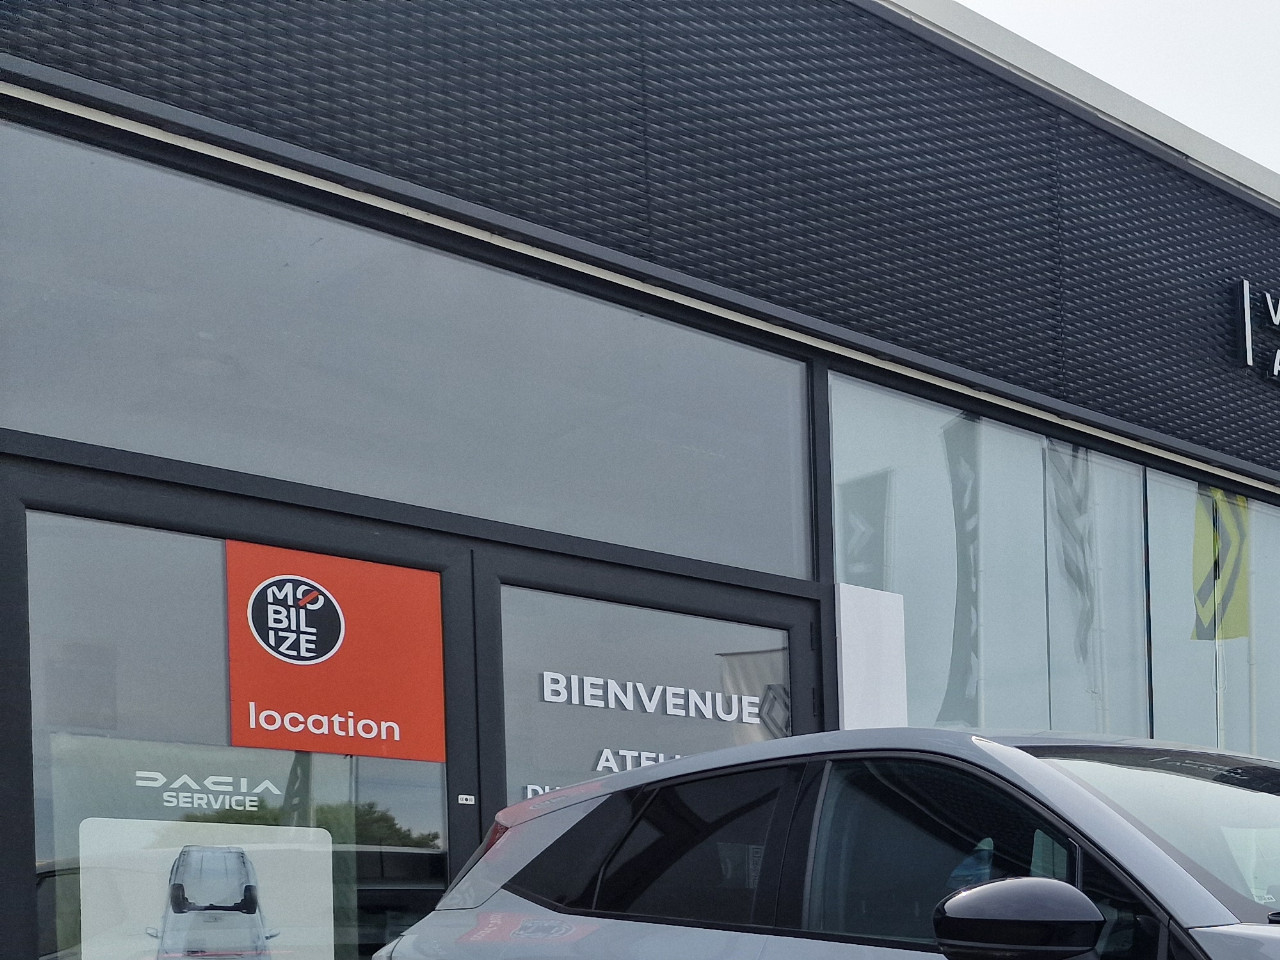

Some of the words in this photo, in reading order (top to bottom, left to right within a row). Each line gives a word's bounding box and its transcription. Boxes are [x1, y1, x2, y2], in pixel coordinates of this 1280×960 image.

[543, 671, 761, 724] BIENVENUE
[248, 701, 401, 741] location
[135, 770, 283, 795] DACIA
[162, 791, 260, 812] SERVICE
